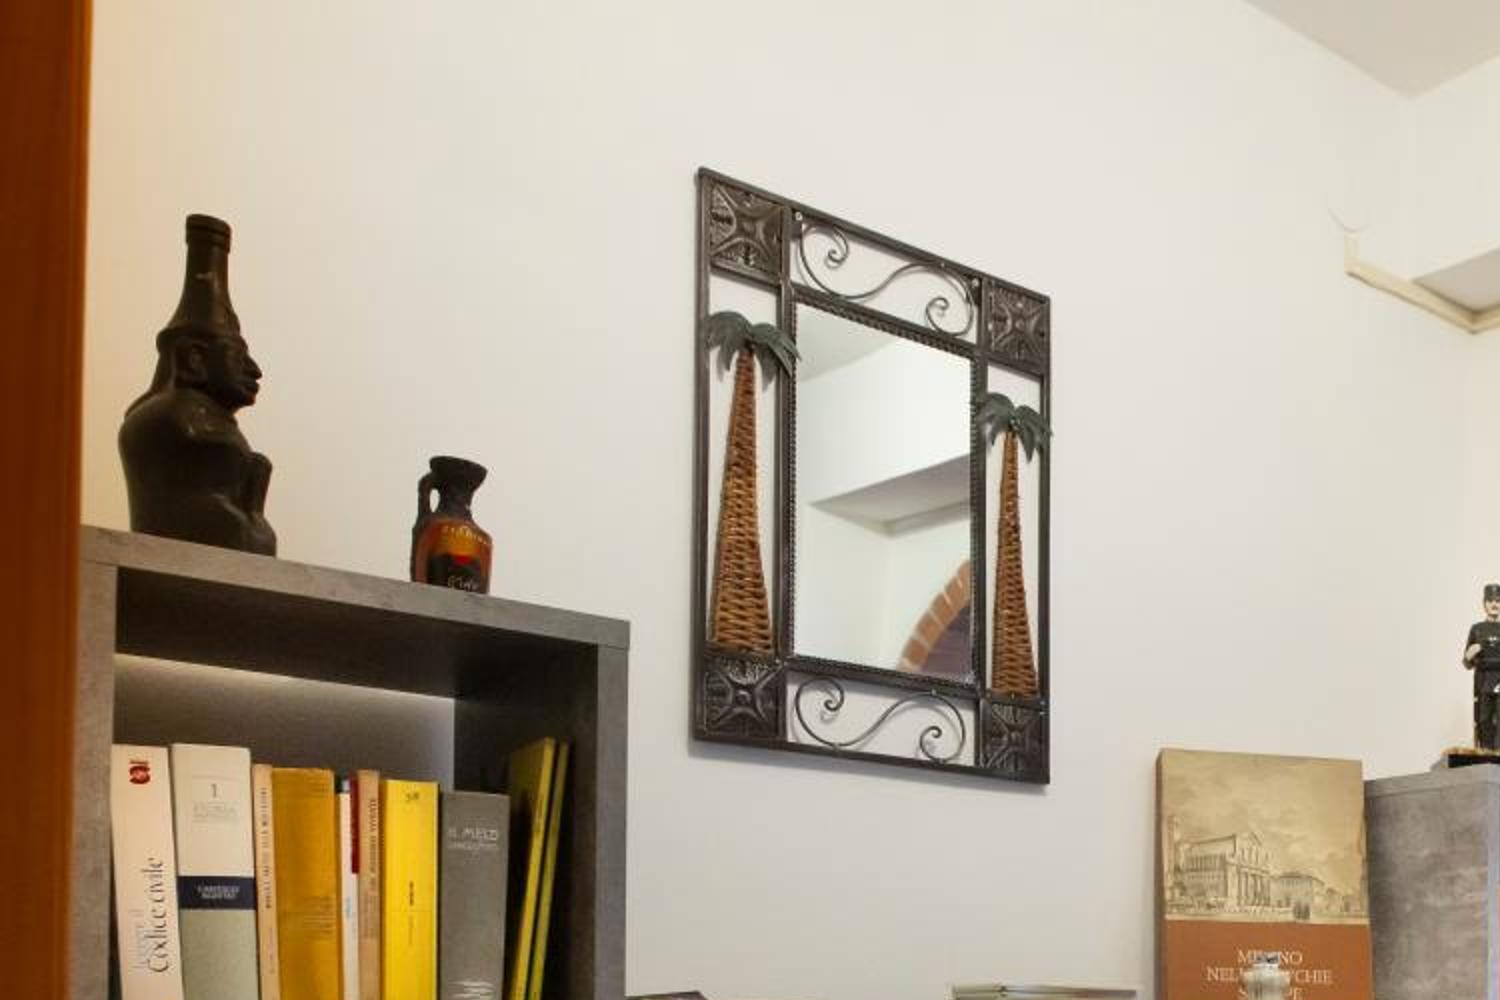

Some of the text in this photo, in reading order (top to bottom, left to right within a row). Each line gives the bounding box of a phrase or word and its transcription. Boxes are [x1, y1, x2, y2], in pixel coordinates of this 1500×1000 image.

[141, 857, 169, 973] Codice civile
[1237, 949, 1304, 966] MINO
